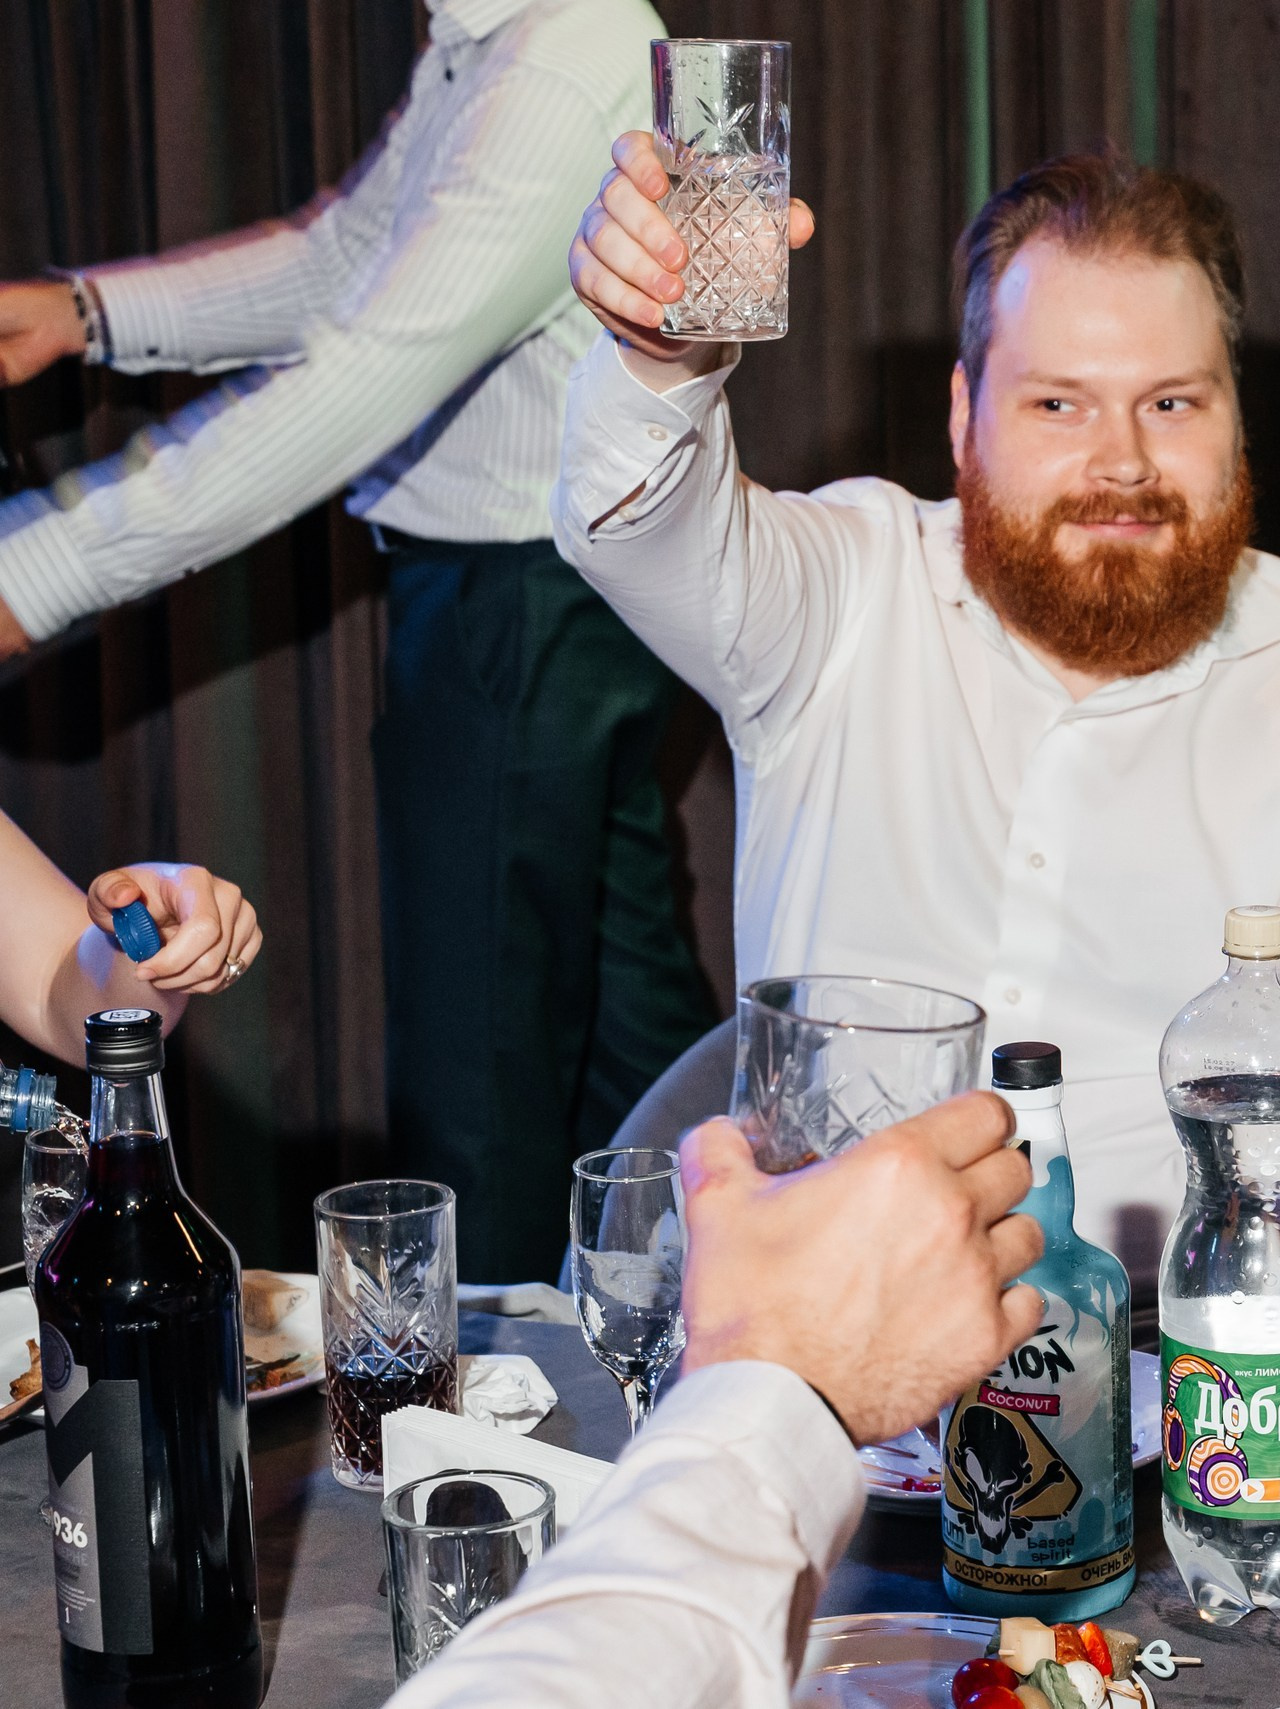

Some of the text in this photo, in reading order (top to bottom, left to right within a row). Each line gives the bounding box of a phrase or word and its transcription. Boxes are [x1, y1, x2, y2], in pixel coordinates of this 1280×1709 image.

[988, 1338, 1075, 1384] ION
[987, 1391, 1052, 1410] COCONUT
[1027, 1534, 1075, 1549] based
[1031, 1548, 1072, 1564] spirit
[954, 1559, 1048, 1587] ОСТОРОЖНО!
[1080, 1560, 1122, 1582] ОЧЕНЬ
